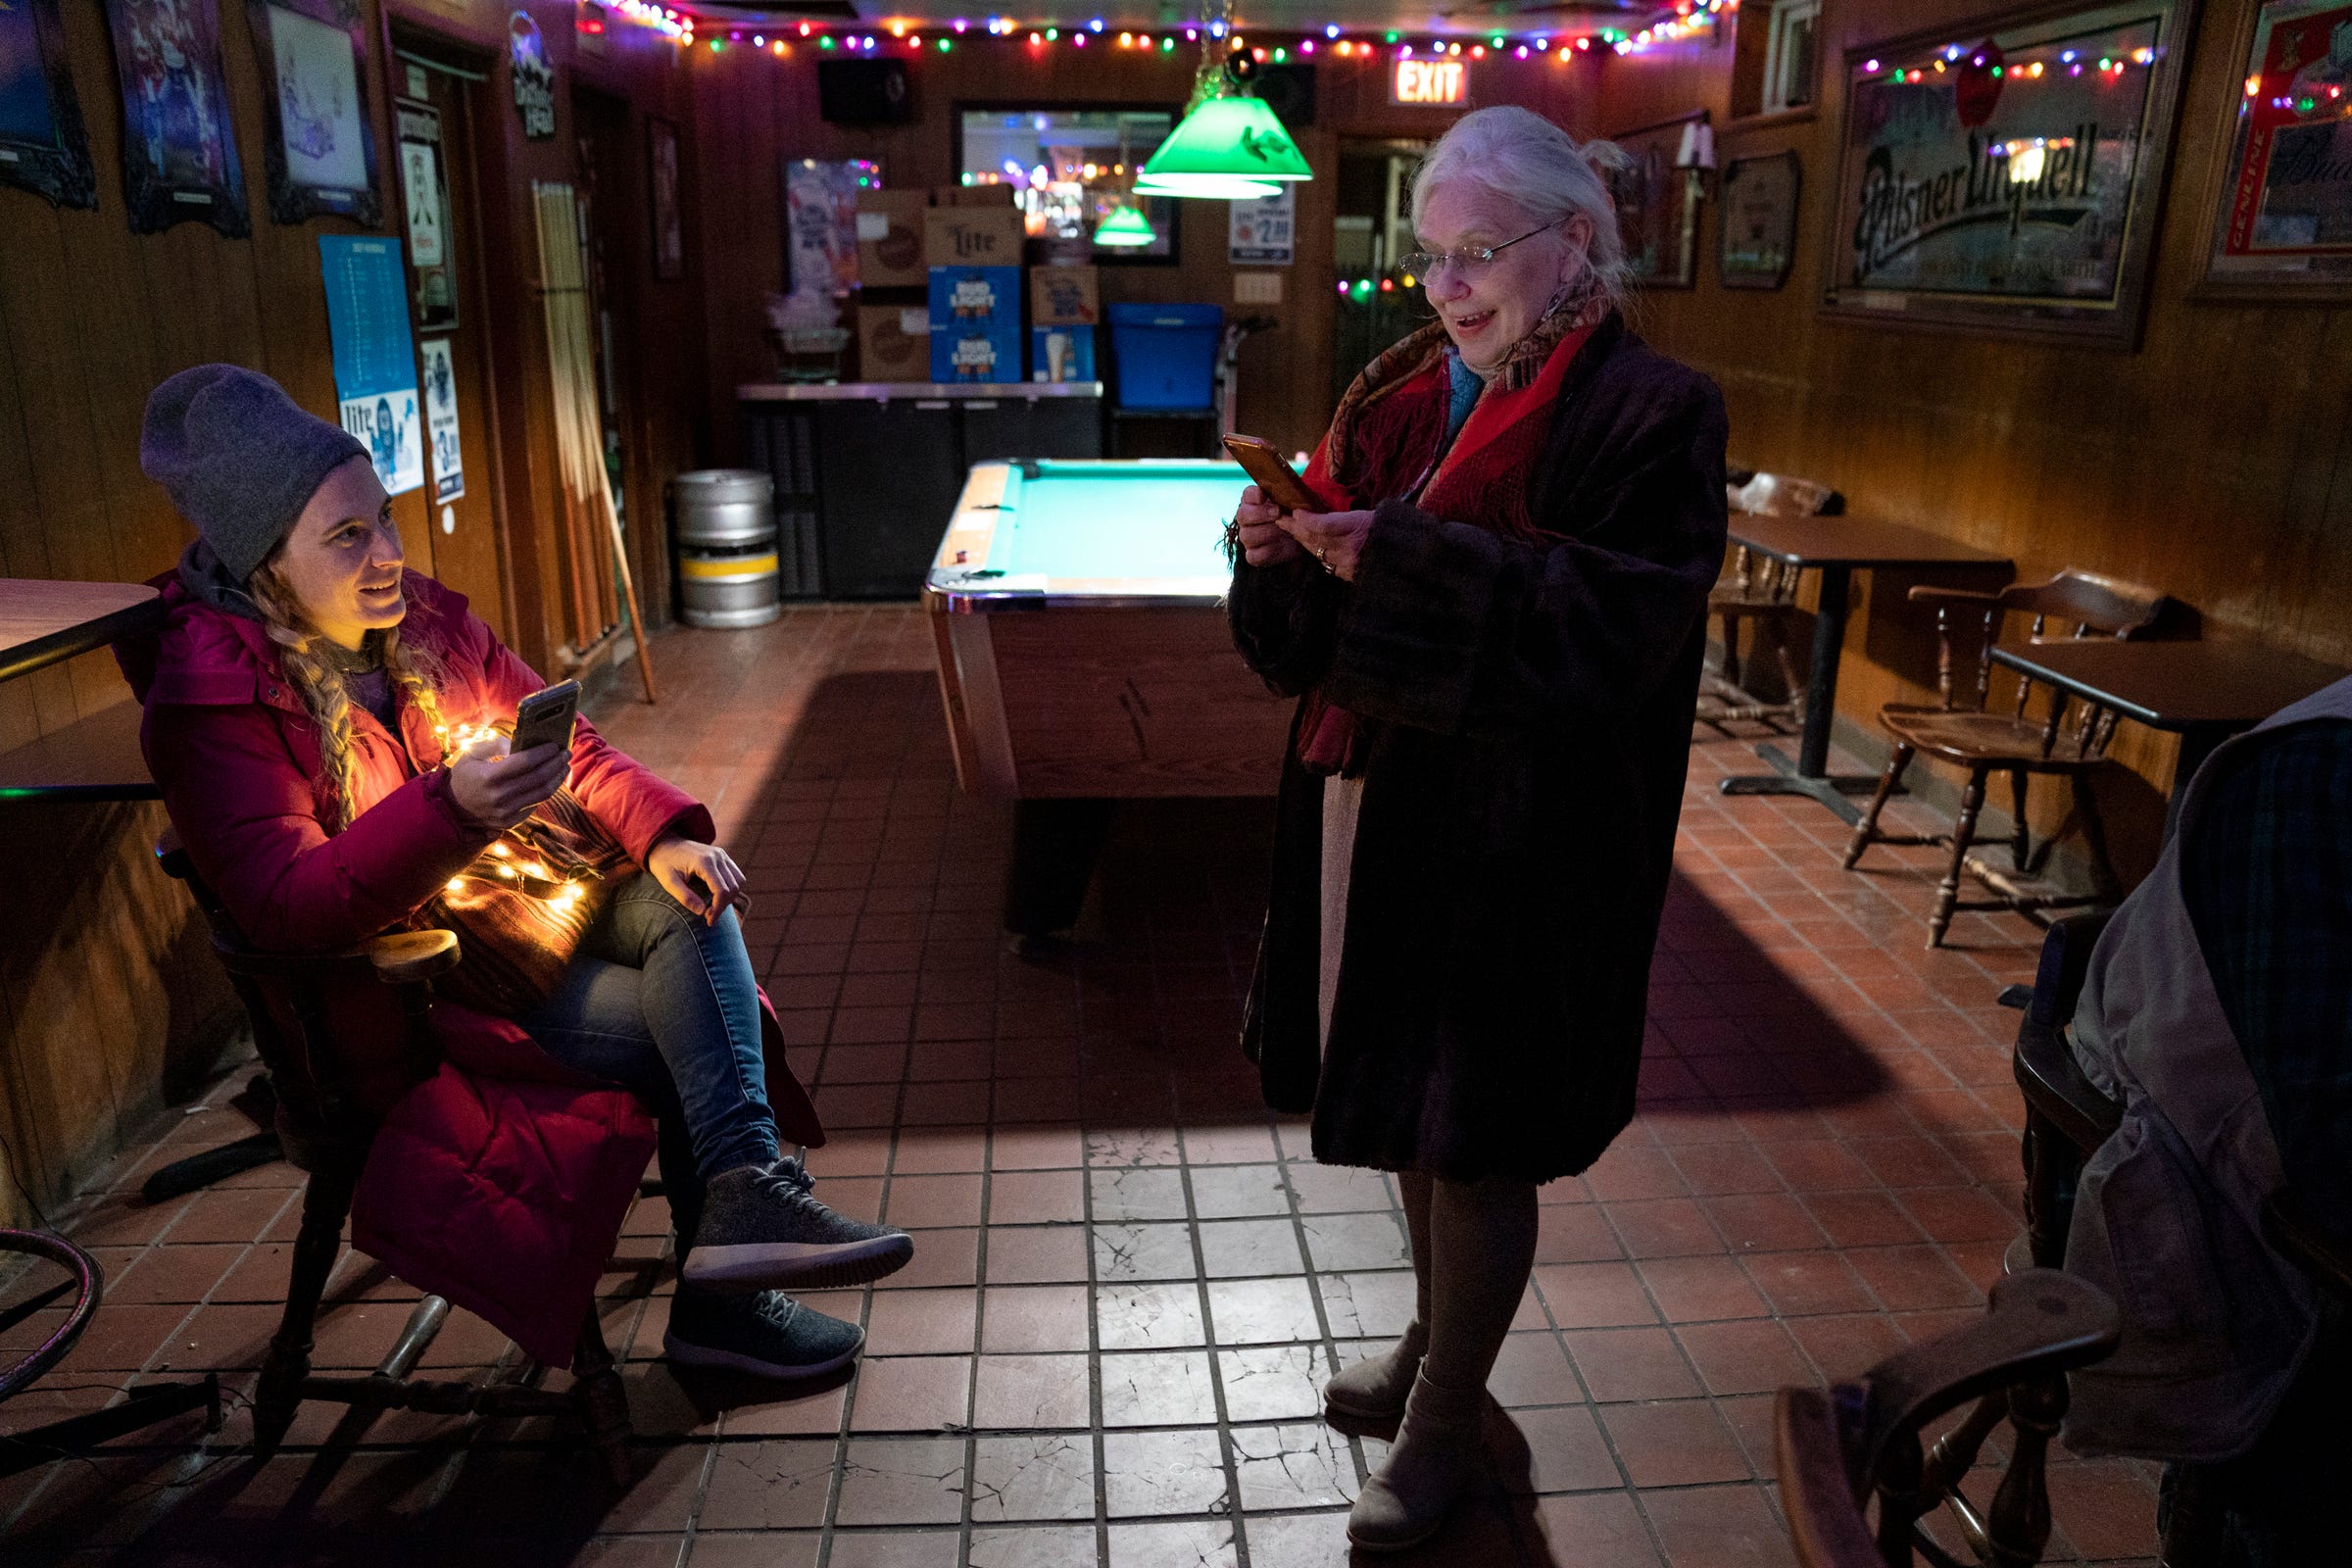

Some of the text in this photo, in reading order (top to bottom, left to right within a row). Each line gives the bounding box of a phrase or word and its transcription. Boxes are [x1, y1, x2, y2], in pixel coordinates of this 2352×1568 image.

[1396, 60, 1463, 103] EXIT
[1853, 122, 2098, 278] Pilsner Urquell
[2232, 126, 2266, 250] GENUINE
[948, 222, 996, 258] Lite
[345, 405, 373, 434] lite
